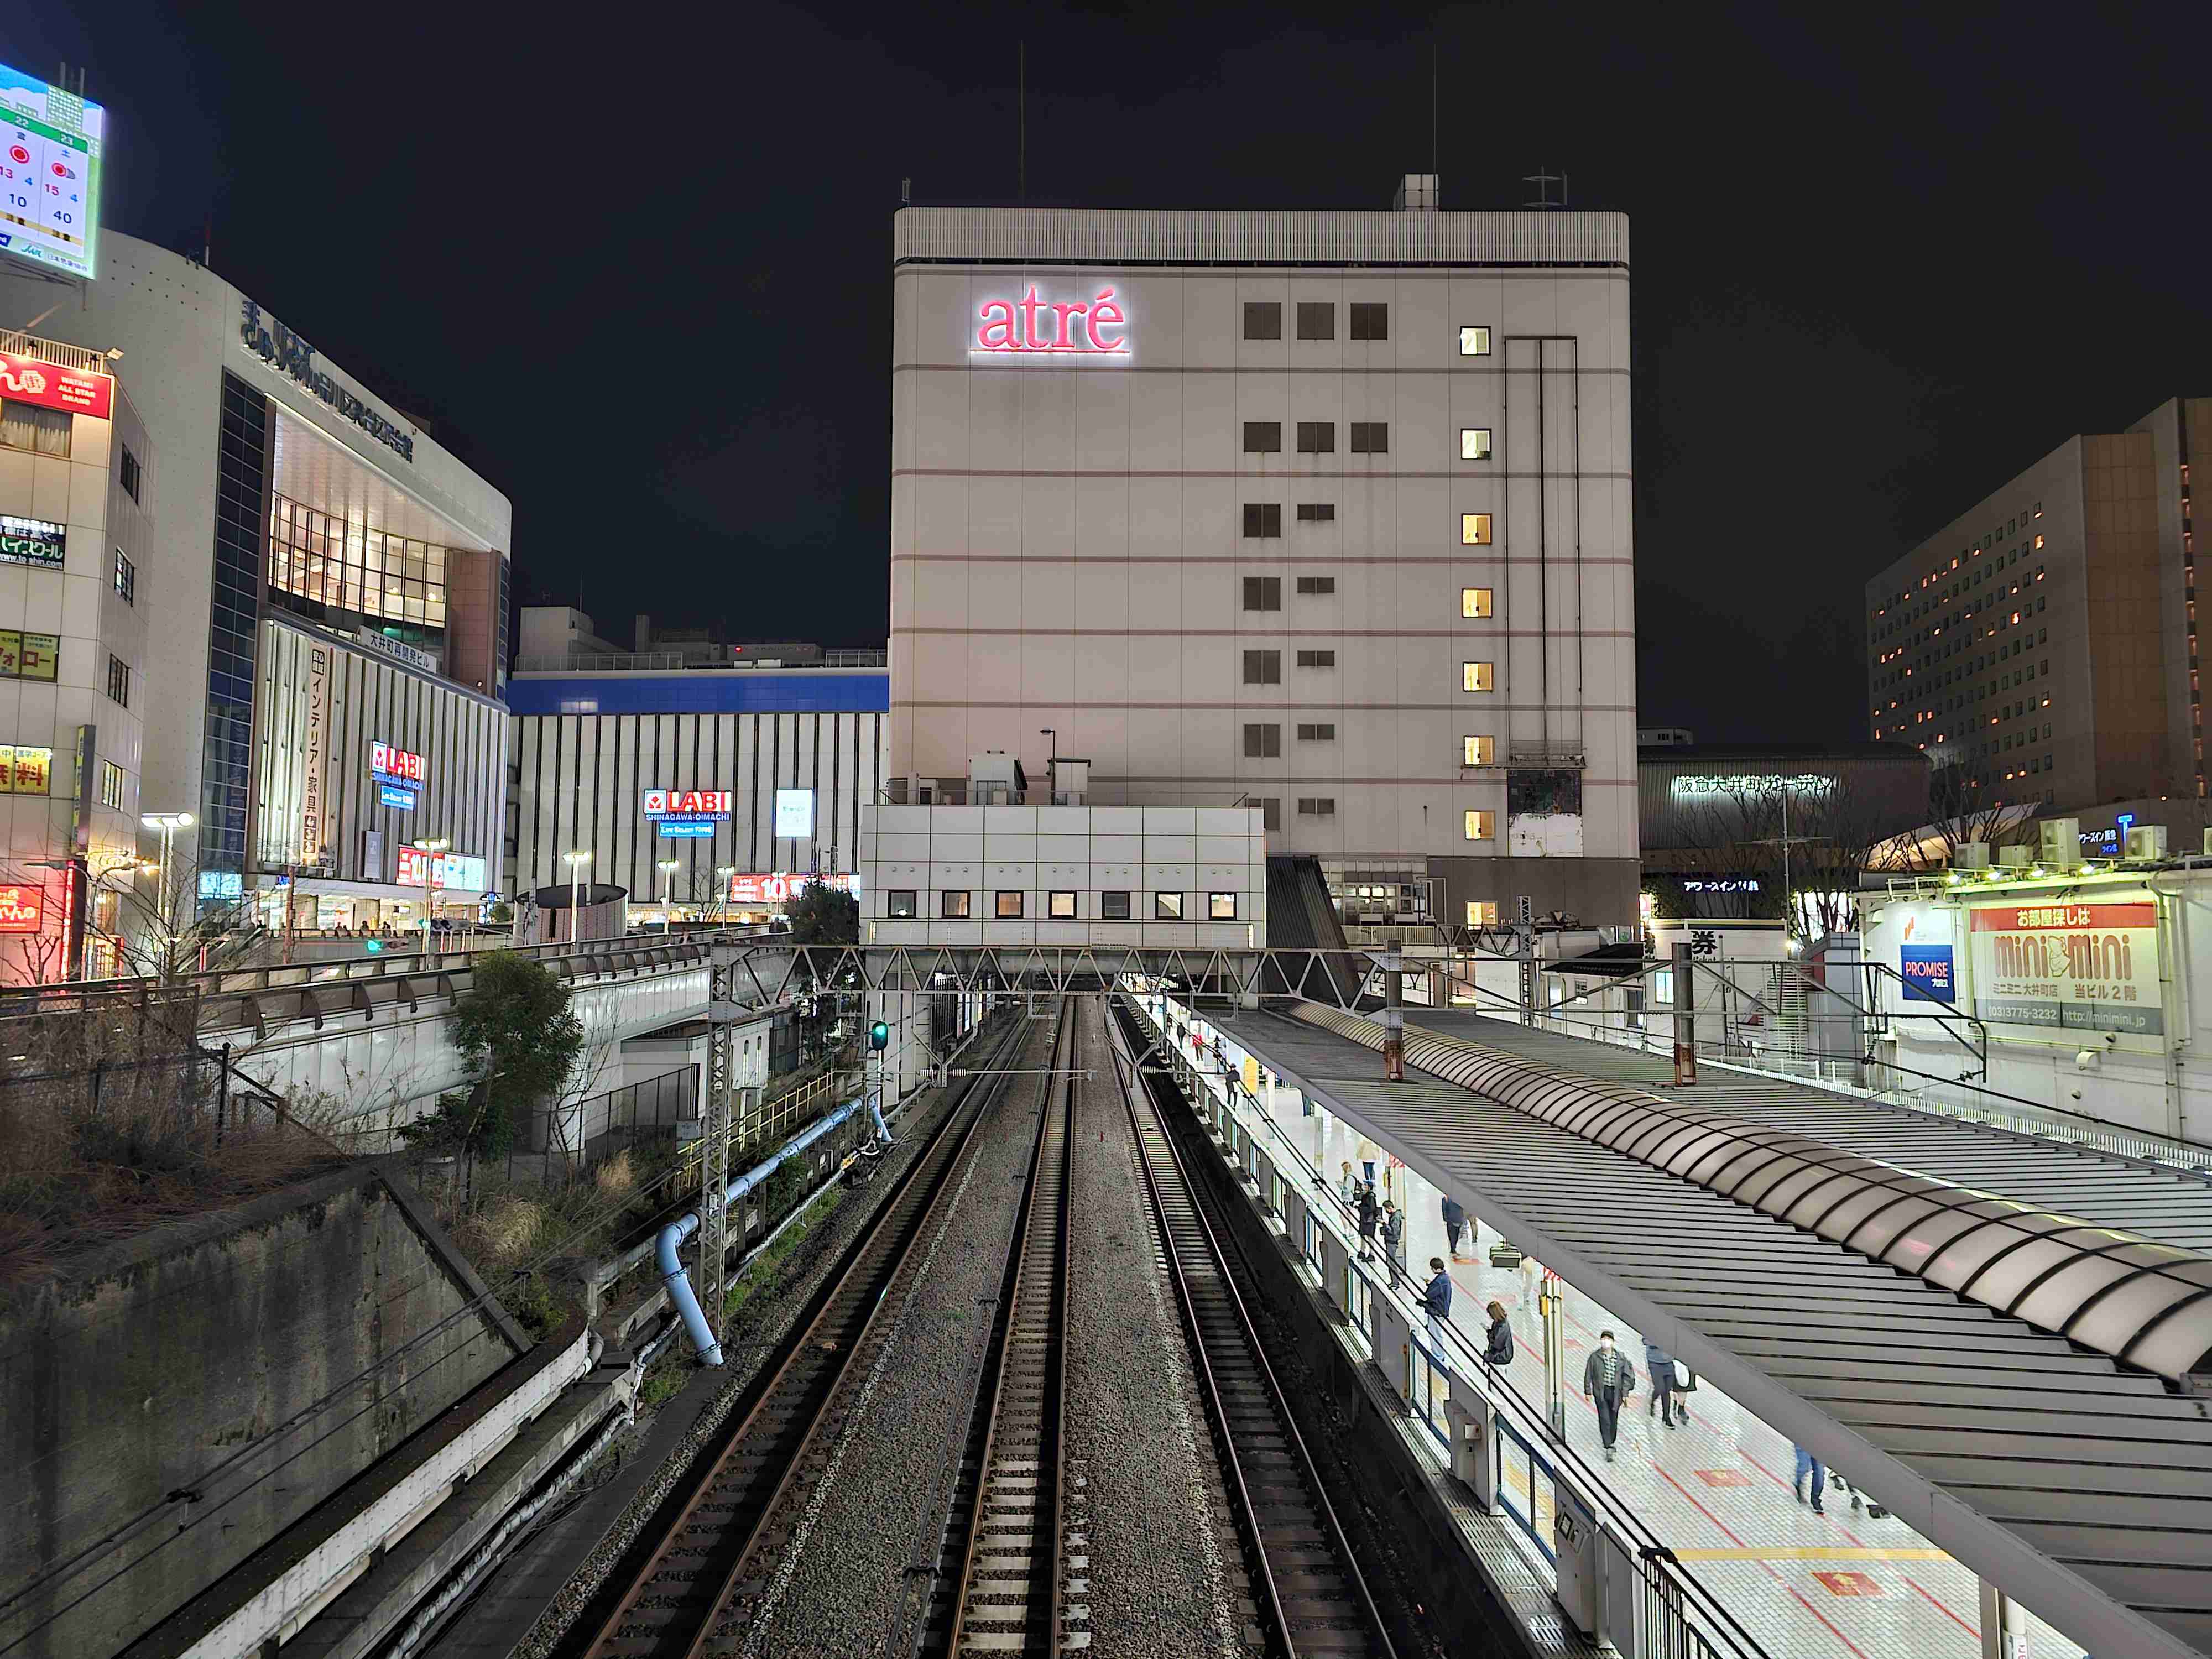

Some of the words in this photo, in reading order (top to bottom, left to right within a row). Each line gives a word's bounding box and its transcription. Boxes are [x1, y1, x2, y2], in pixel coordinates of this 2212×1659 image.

[44, 184, 59, 195] 15
[9, 194, 27, 207] 10
[53, 210, 72, 224] 40
[978, 283, 1125, 350] atré
[75, 388, 96, 399] STAR
[387, 748, 425, 780] LABI
[667, 791, 732, 812] LABI
[2017, 907, 2091, 927] お部屋探しは
[1691, 931, 1718, 955] 券
[1905, 961, 1948, 978] PROMISE
[1987, 1006, 2057, 1020] (03)3775-3232
